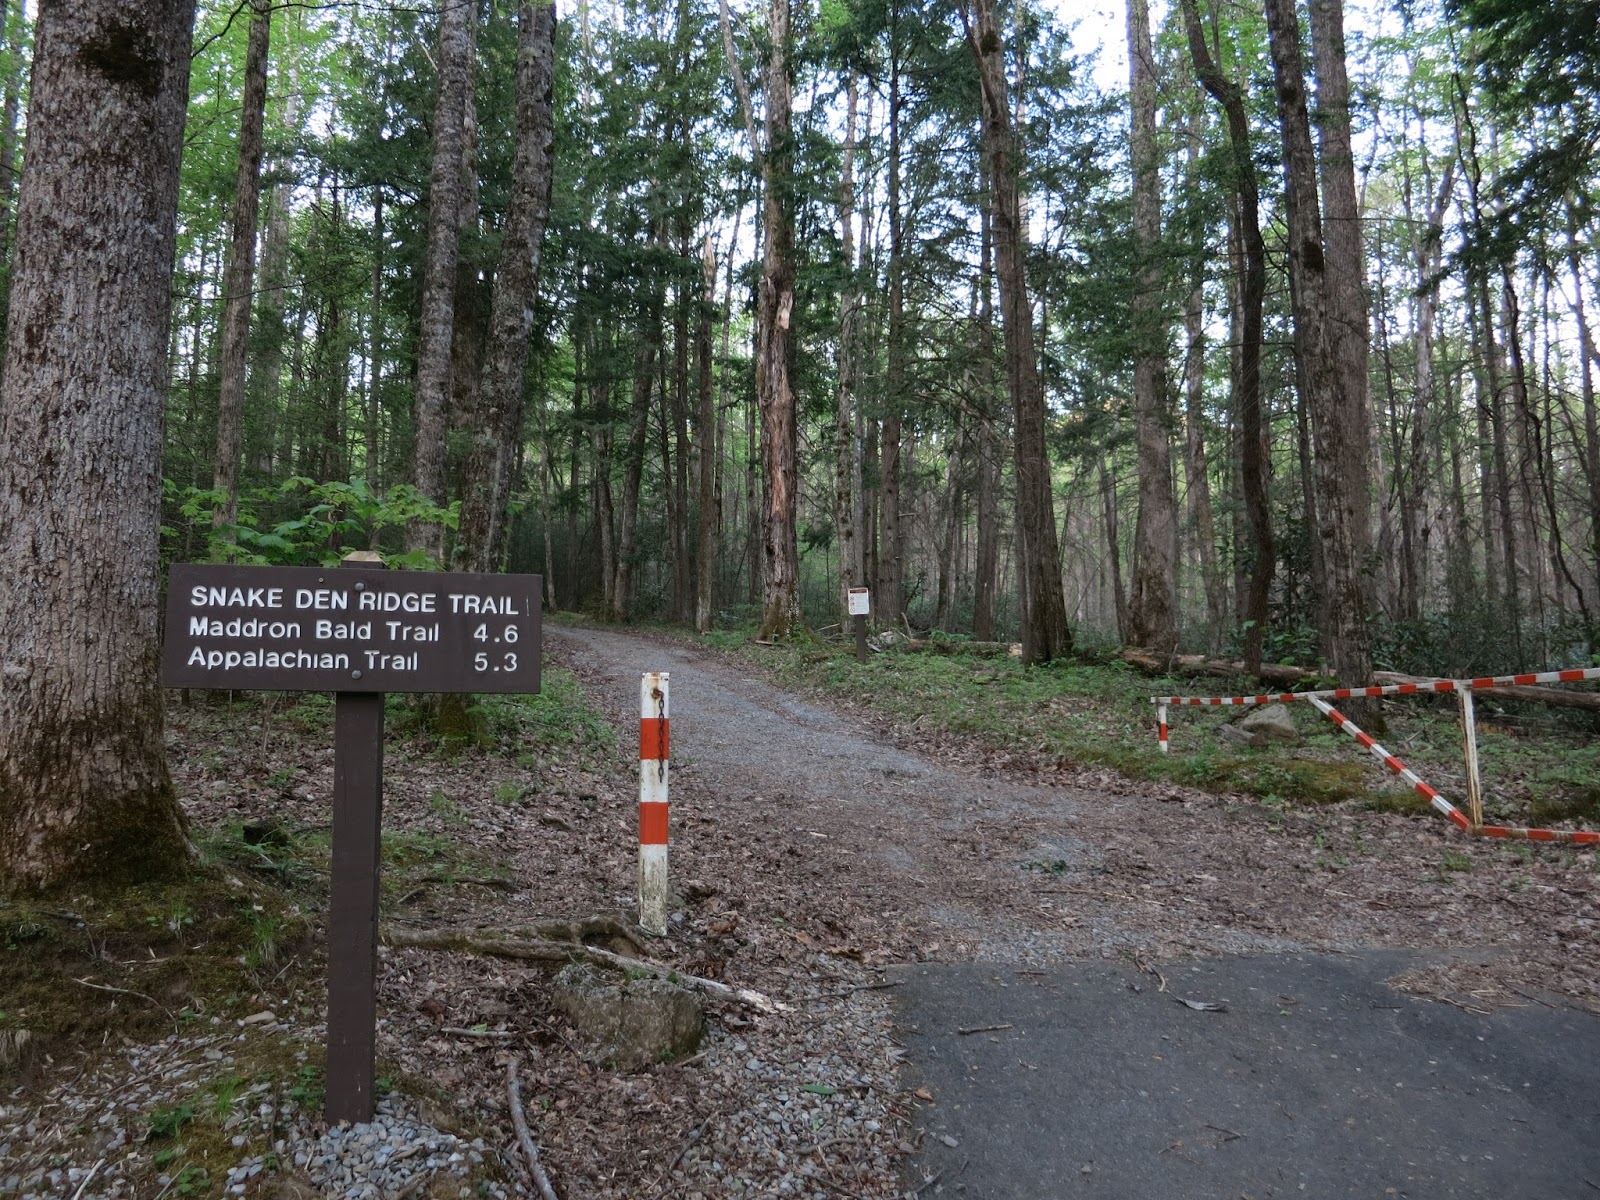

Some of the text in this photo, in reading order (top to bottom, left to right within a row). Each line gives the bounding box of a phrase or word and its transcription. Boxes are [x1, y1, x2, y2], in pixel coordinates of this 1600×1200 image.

[190, 585, 519, 615] SNAKE DEN RIDGE TRAIL
[189, 616, 519, 644] Maddron Bald Trail 4.6
[187, 645, 518, 672] Appalachian Trail 5.3
